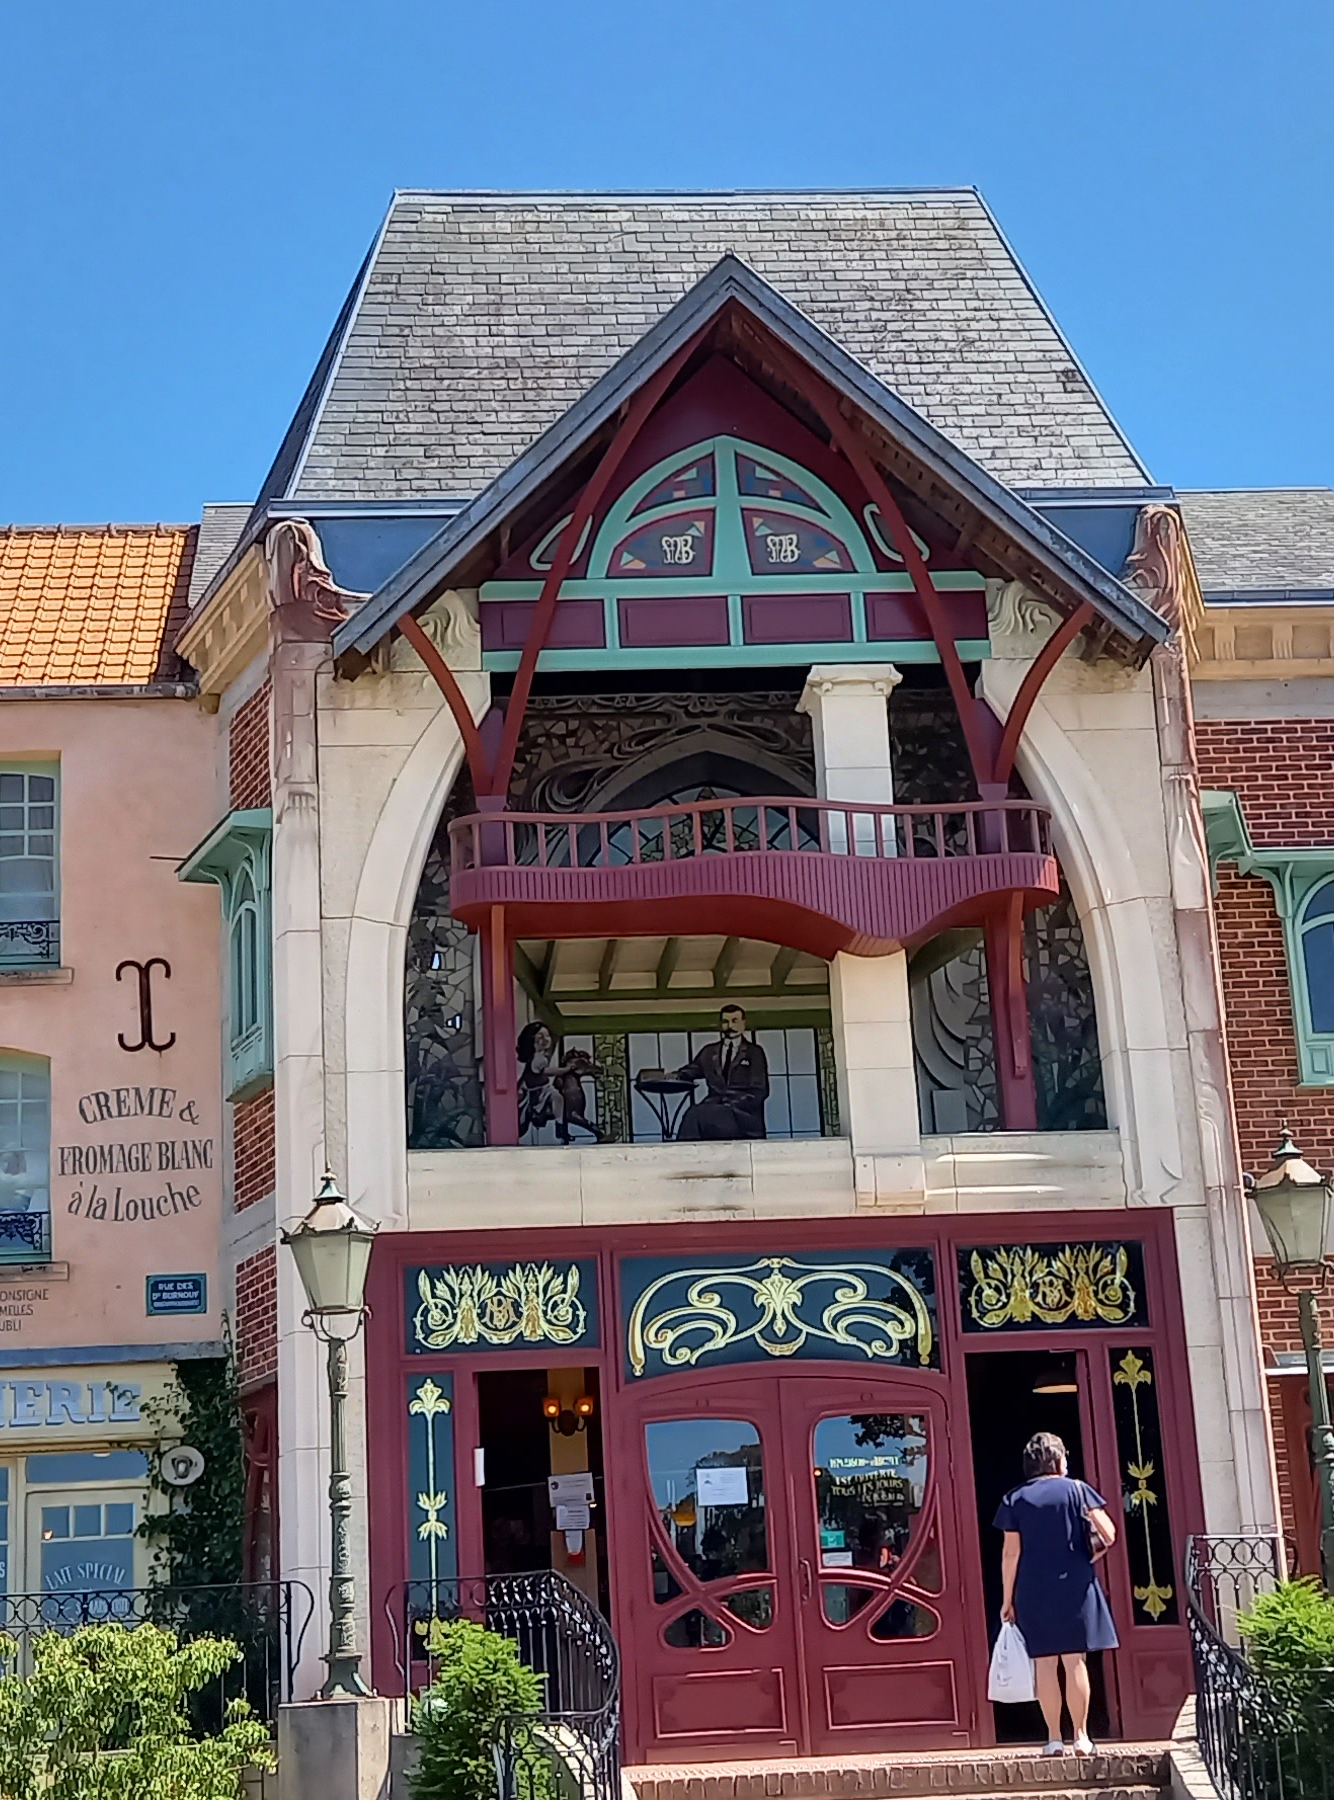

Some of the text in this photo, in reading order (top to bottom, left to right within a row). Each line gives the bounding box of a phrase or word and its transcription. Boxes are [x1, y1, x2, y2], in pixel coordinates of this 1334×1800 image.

[77, 1086, 200, 1125] CREME &
[57, 1138, 214, 1176] FROMAGE BLANC
[84, 1184, 108, 1220] la
